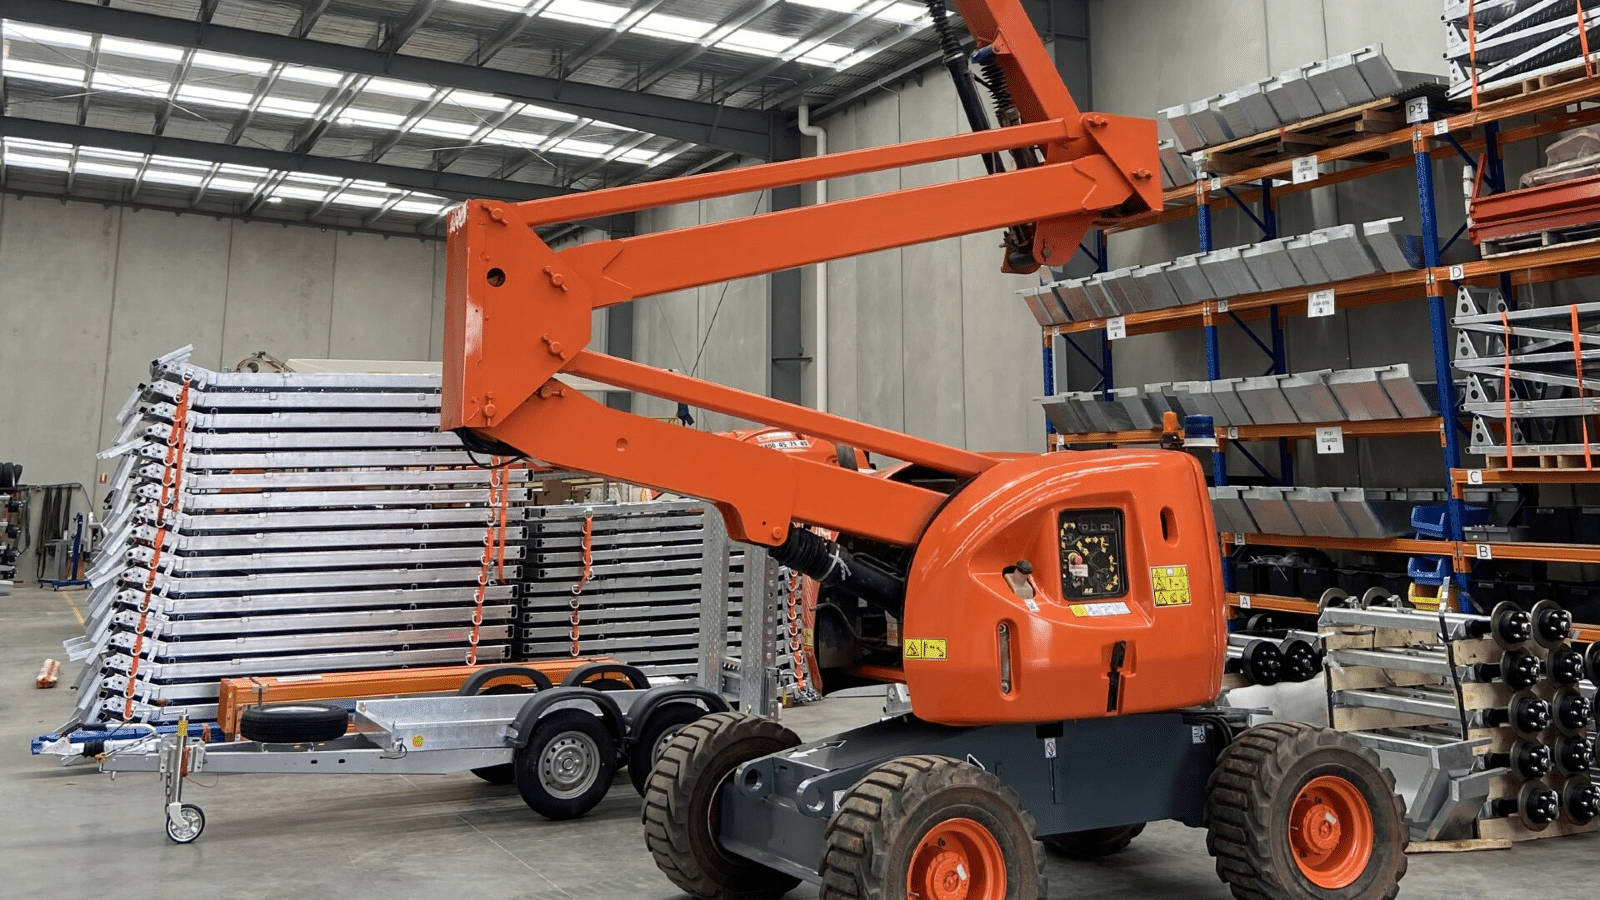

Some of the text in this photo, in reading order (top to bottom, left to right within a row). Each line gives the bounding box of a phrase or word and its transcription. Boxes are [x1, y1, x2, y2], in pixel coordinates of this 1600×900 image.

[1409, 102, 1423, 116] P3
[1437, 122, 1444, 133] E
[1452, 266, 1462, 278] D
[1230, 427, 1236, 438] C
[1471, 471, 1479, 483] C
[1237, 533, 1243, 543] B
[1479, 545, 1488, 558] B
[1242, 596, 1249, 607] A
